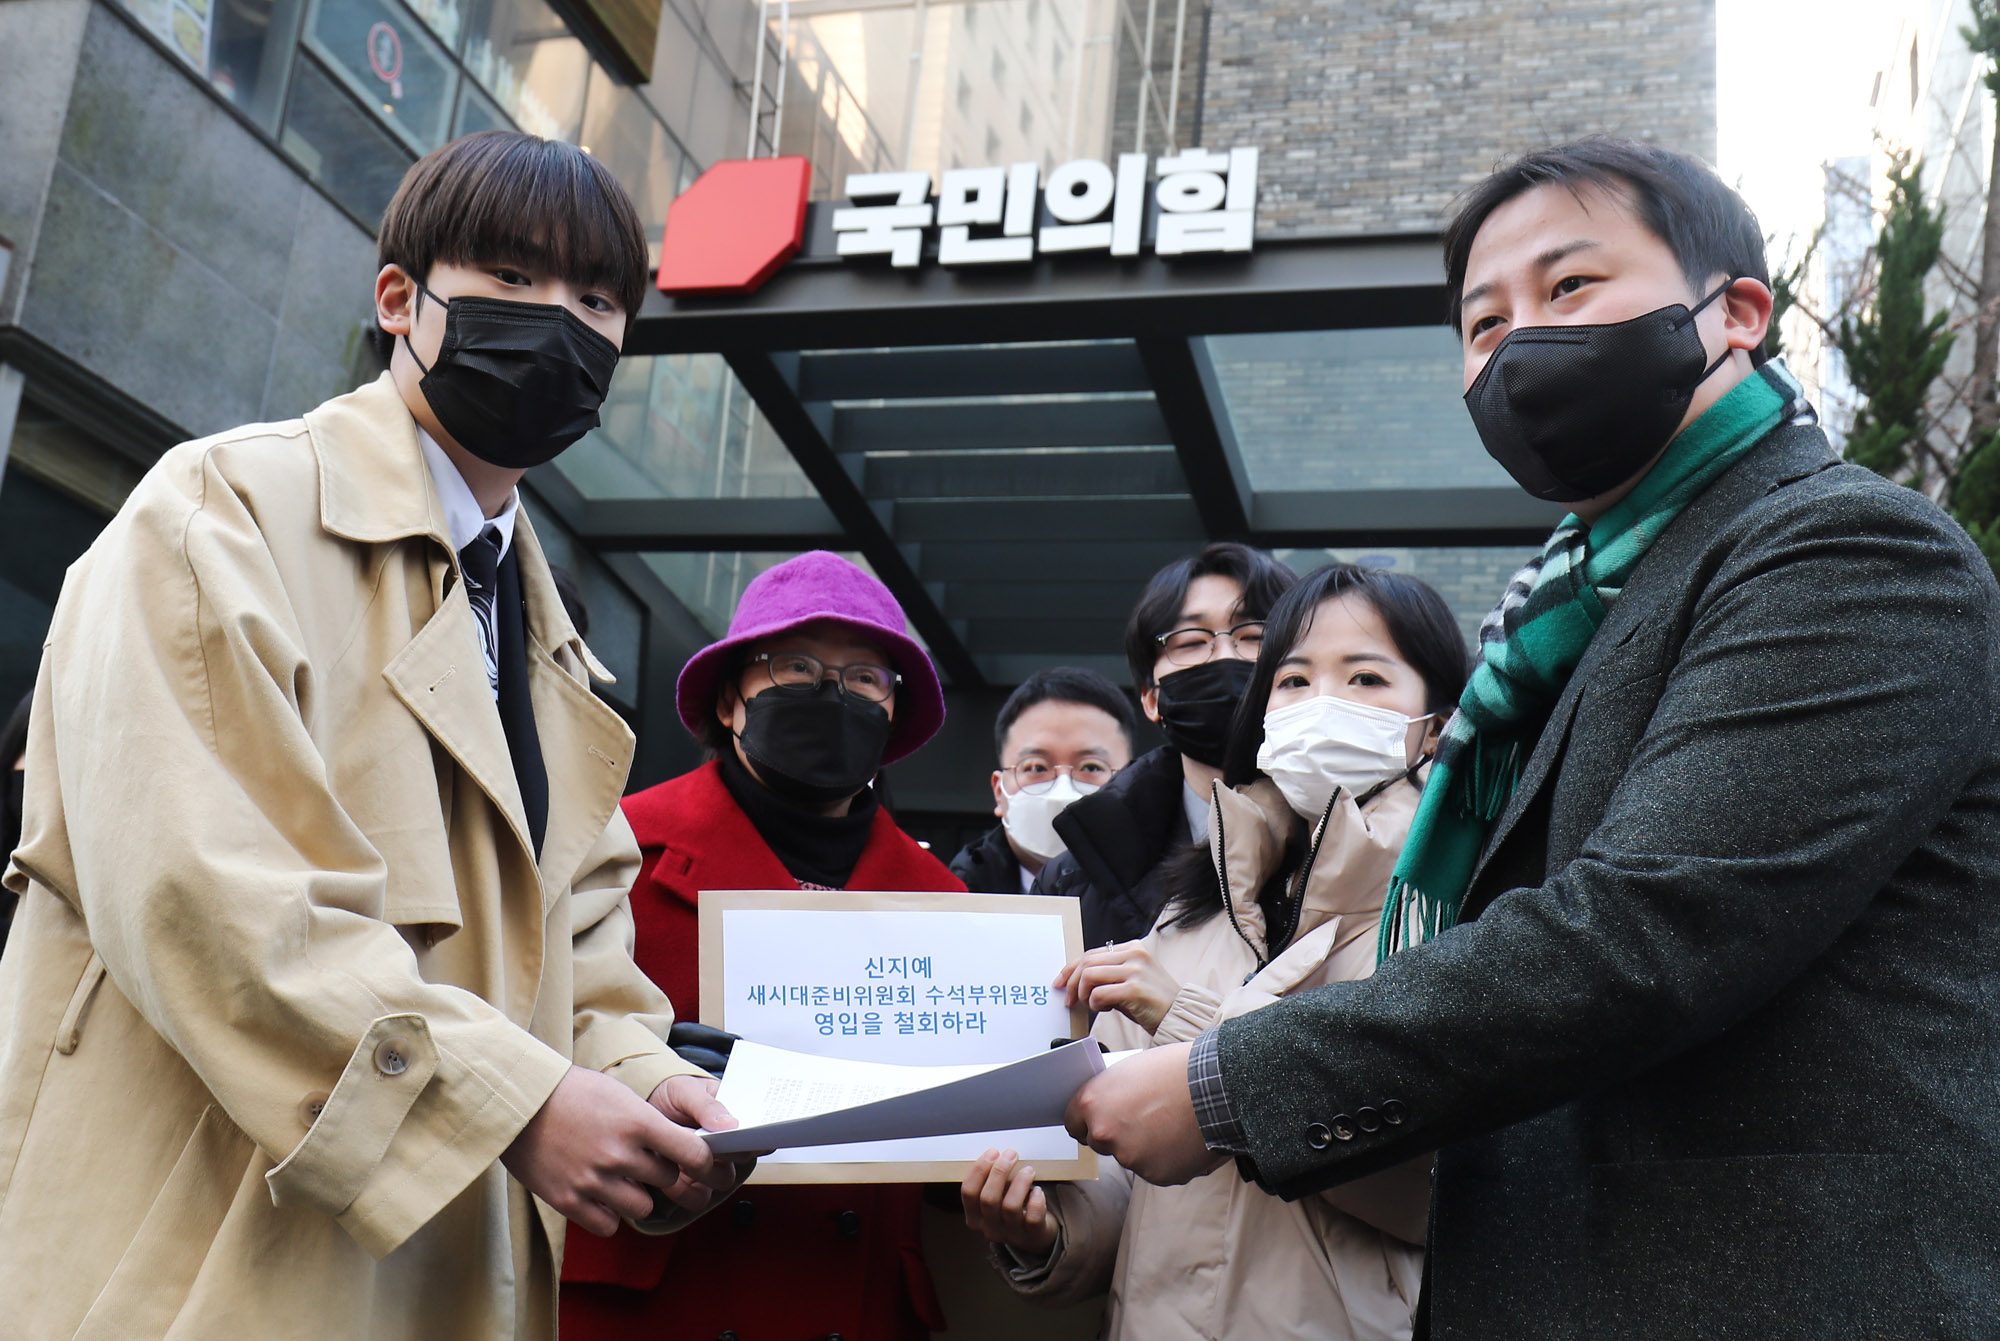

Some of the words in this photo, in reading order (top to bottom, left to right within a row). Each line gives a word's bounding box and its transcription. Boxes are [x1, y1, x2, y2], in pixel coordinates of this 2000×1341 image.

[832, 147, 1259, 267] 국민의힘
[864, 956, 932, 980] 신지예
[747, 984, 916, 1007] 새시대준비위원회
[925, 984, 1049, 1007] 수석부위원장
[814, 1011, 884, 1036] 영입을
[893, 1011, 988, 1036] 철회하라
